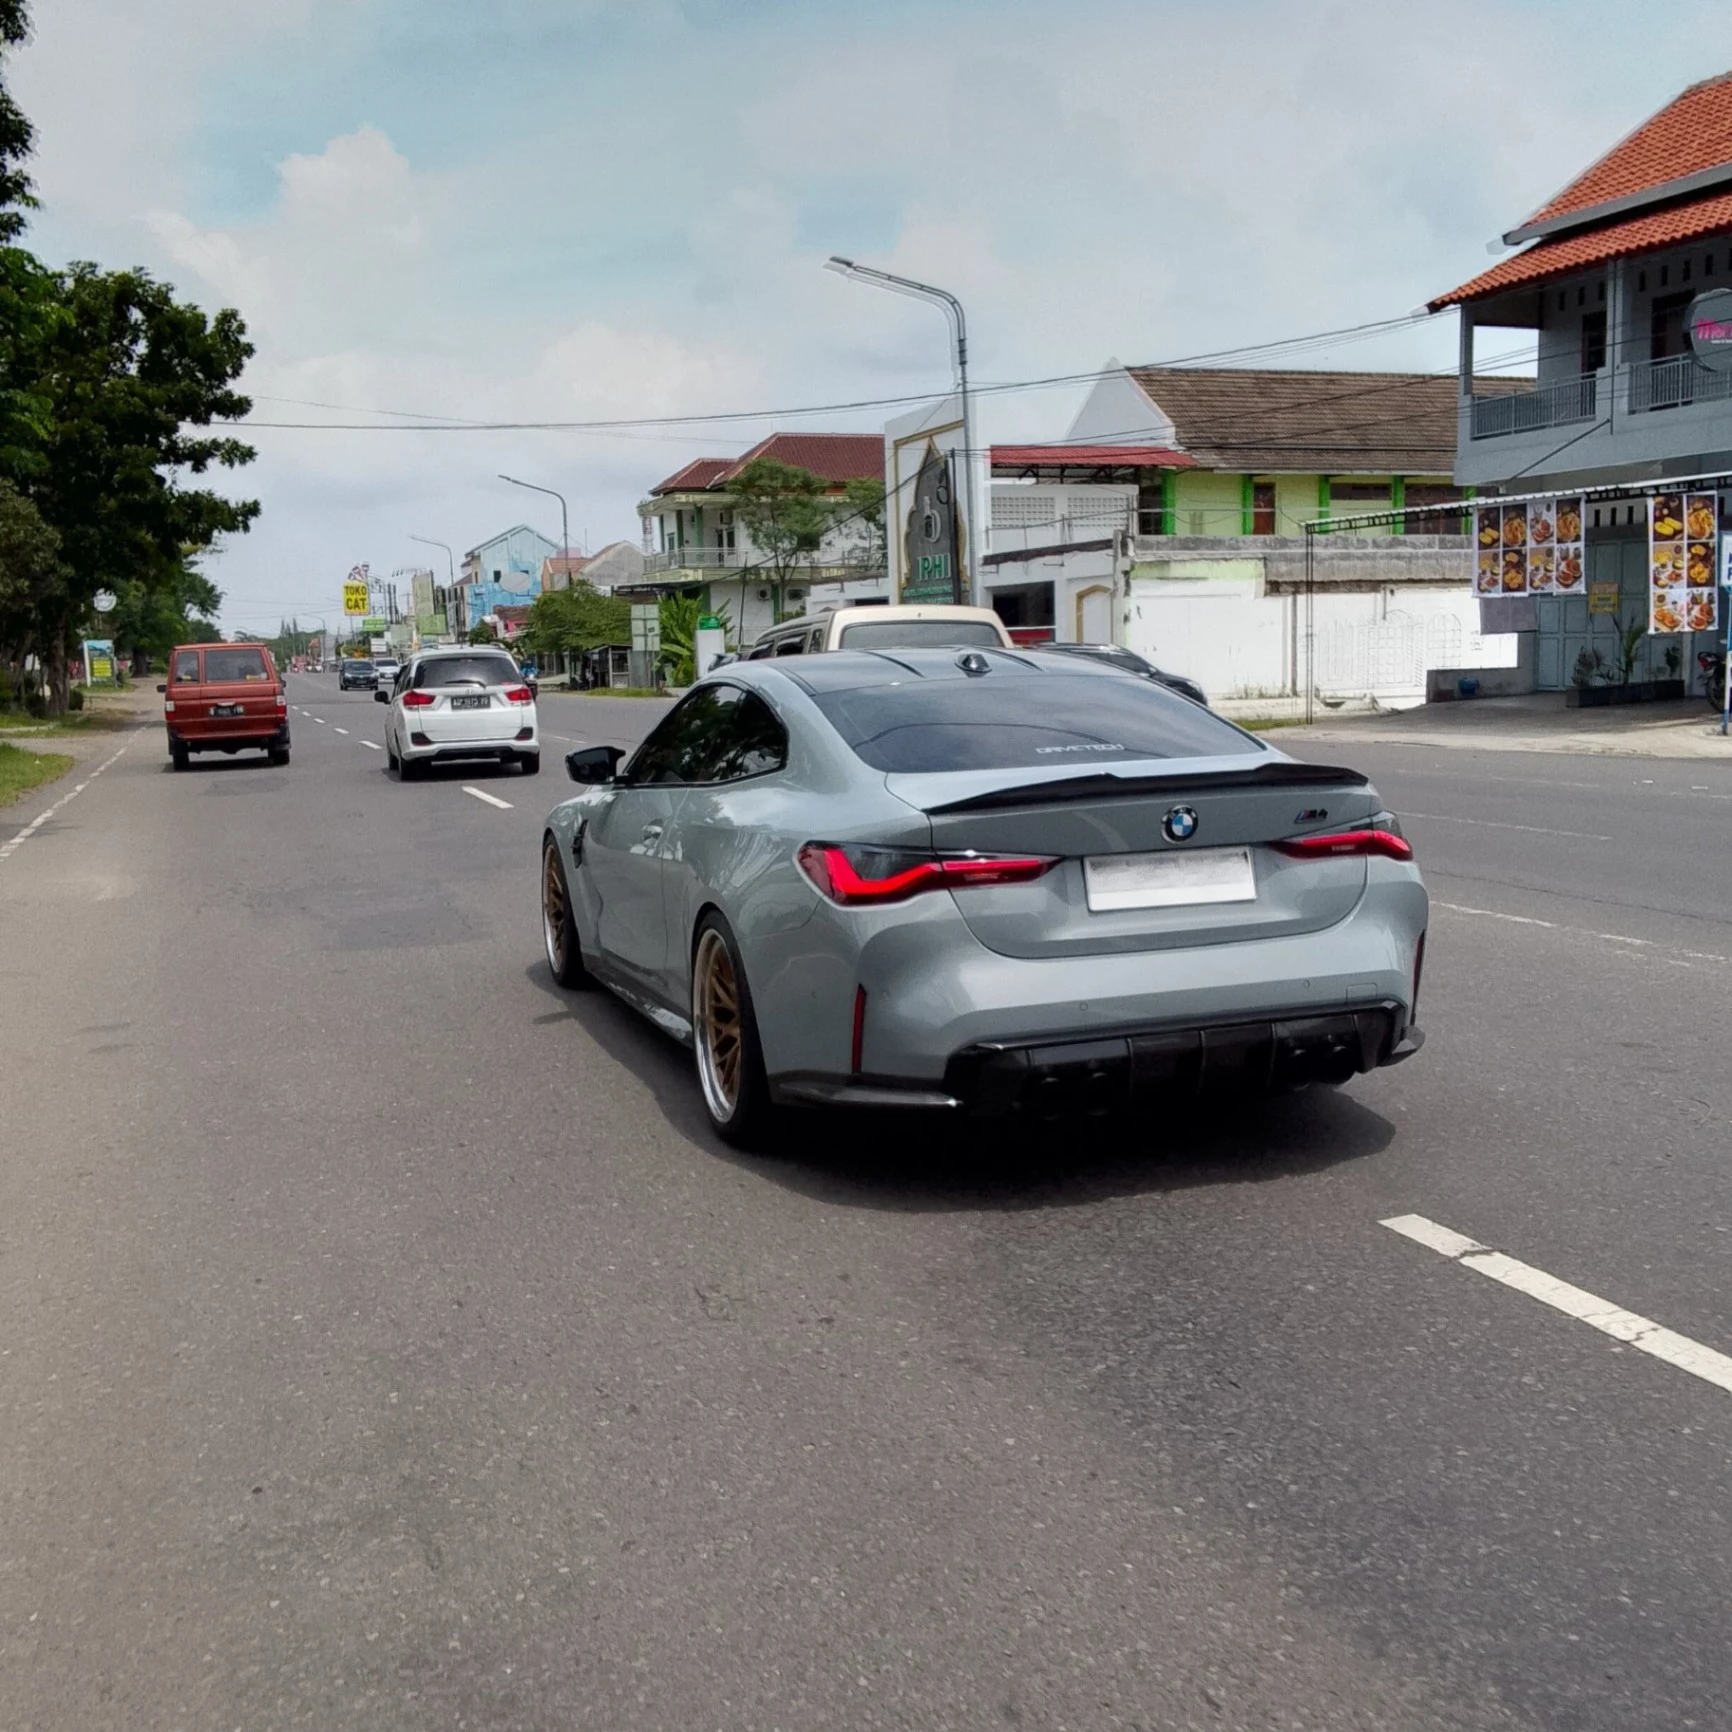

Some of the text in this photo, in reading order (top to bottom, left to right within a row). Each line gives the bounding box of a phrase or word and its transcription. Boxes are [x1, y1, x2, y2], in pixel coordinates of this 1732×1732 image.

[344, 585, 367, 596] TOKO
[346, 597, 367, 611] CAT
[1034, 743, 1125, 754] DRIVETECH
